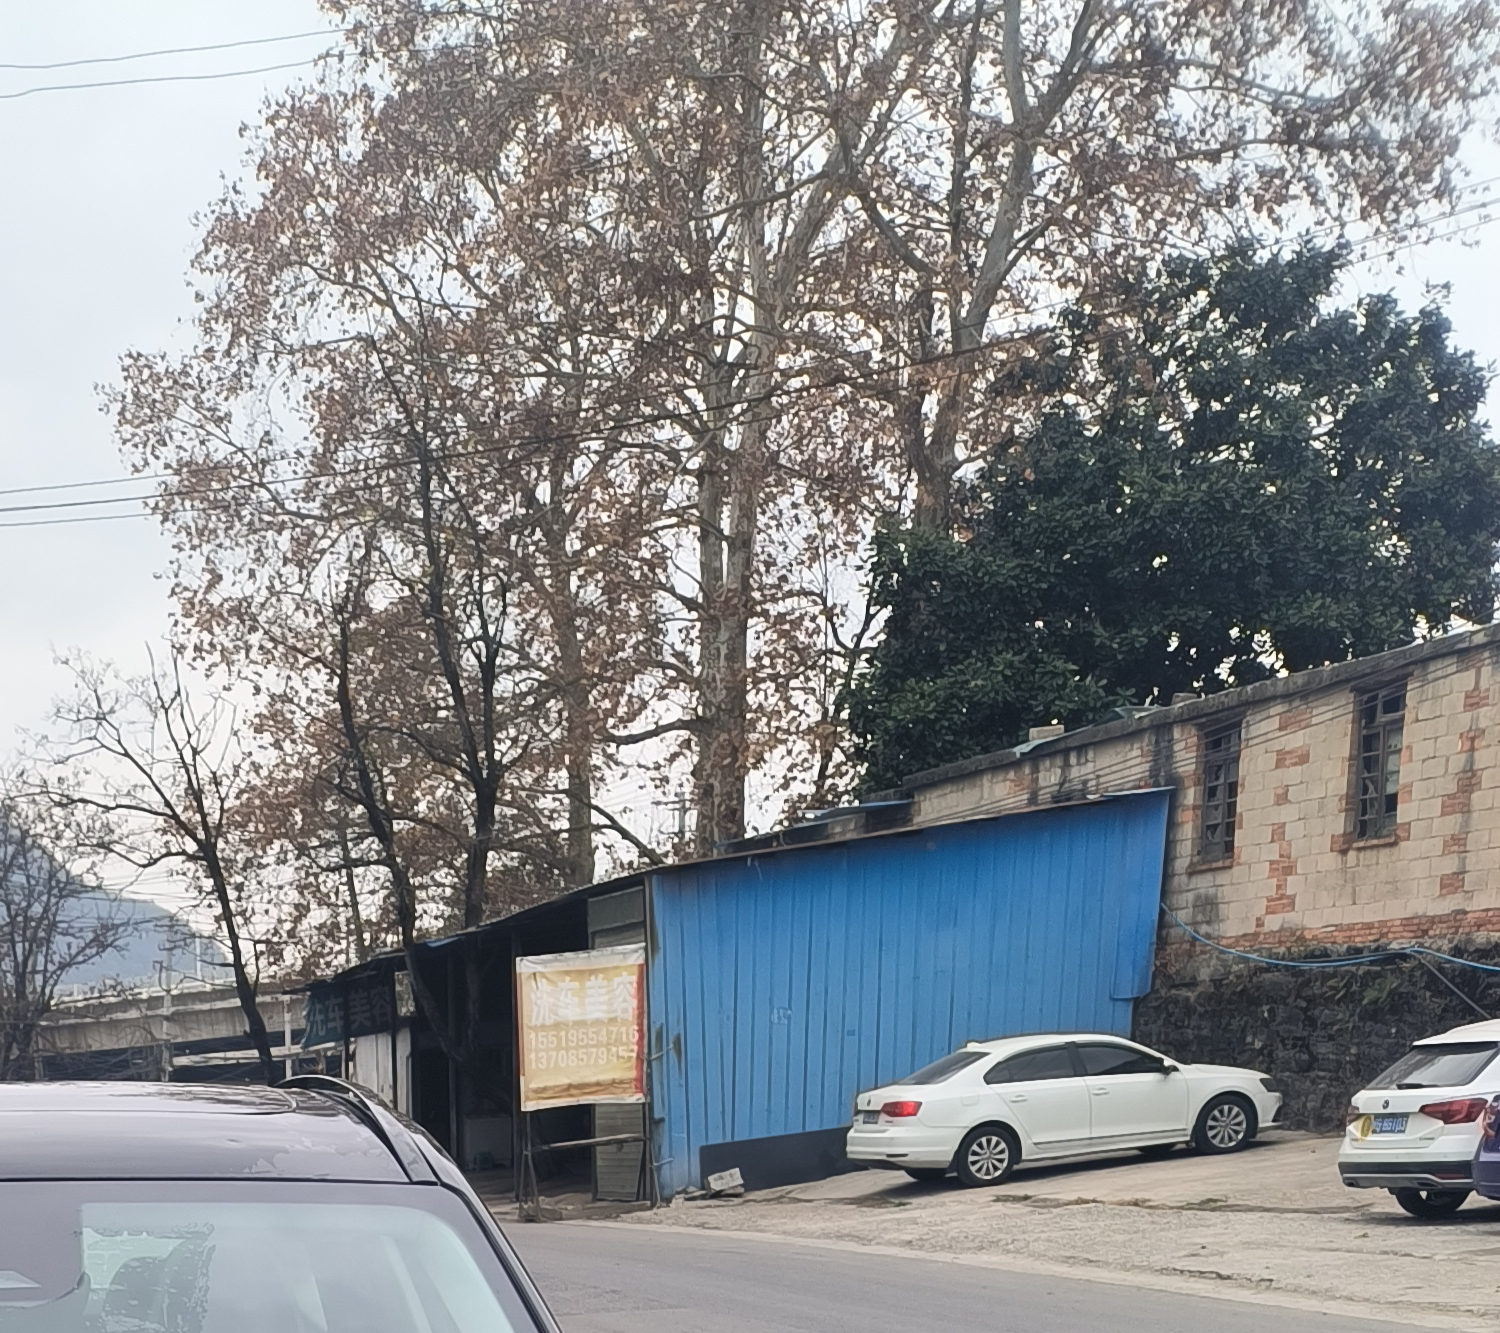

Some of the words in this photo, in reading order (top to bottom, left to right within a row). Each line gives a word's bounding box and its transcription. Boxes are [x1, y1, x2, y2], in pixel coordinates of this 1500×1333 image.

[531, 973, 637, 1025] 洗车美容
[529, 1025, 638, 1050] 15519554716
